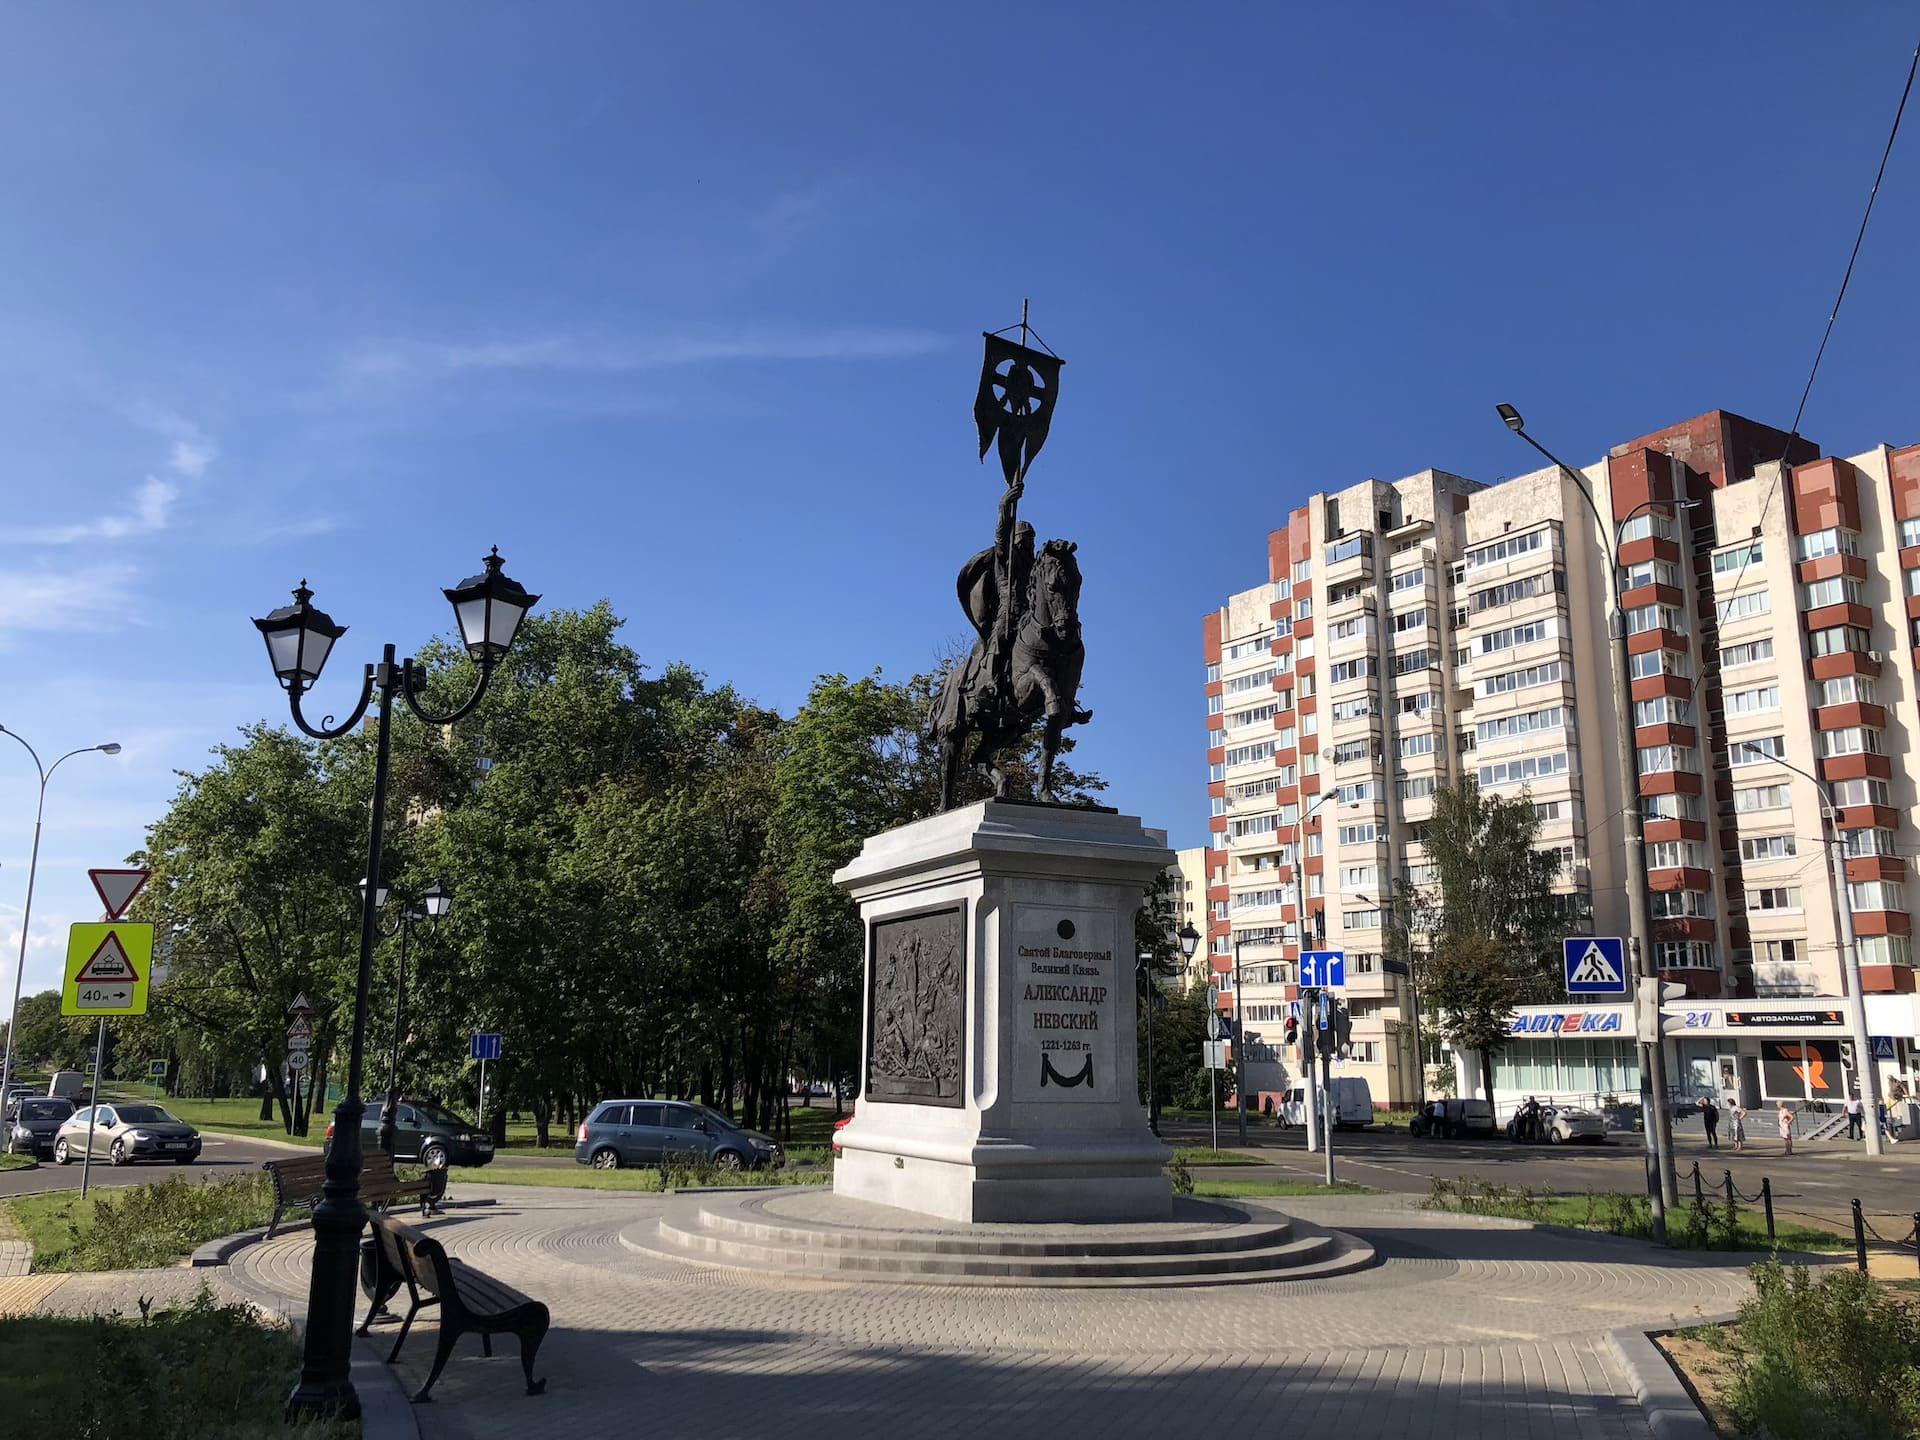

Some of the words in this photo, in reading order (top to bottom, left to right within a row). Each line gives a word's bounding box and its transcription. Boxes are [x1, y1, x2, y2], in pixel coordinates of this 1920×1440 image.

[1018, 945, 1050, 958] Святой
[1053, 947, 1112, 962] Благоверный
[1031, 962, 1070, 975] Великий
[1072, 964, 1099, 976] Князь
[1024, 984, 1107, 1005] АЛЕКСАНДР
[1033, 1010, 1098, 1030] НЕВСКИЙ
[1512, 1013, 1621, 1032] АПТЕКА
[1041, 1040, 1081, 1050] 1221-1263
[292, 1056, 304, 1064] 40
